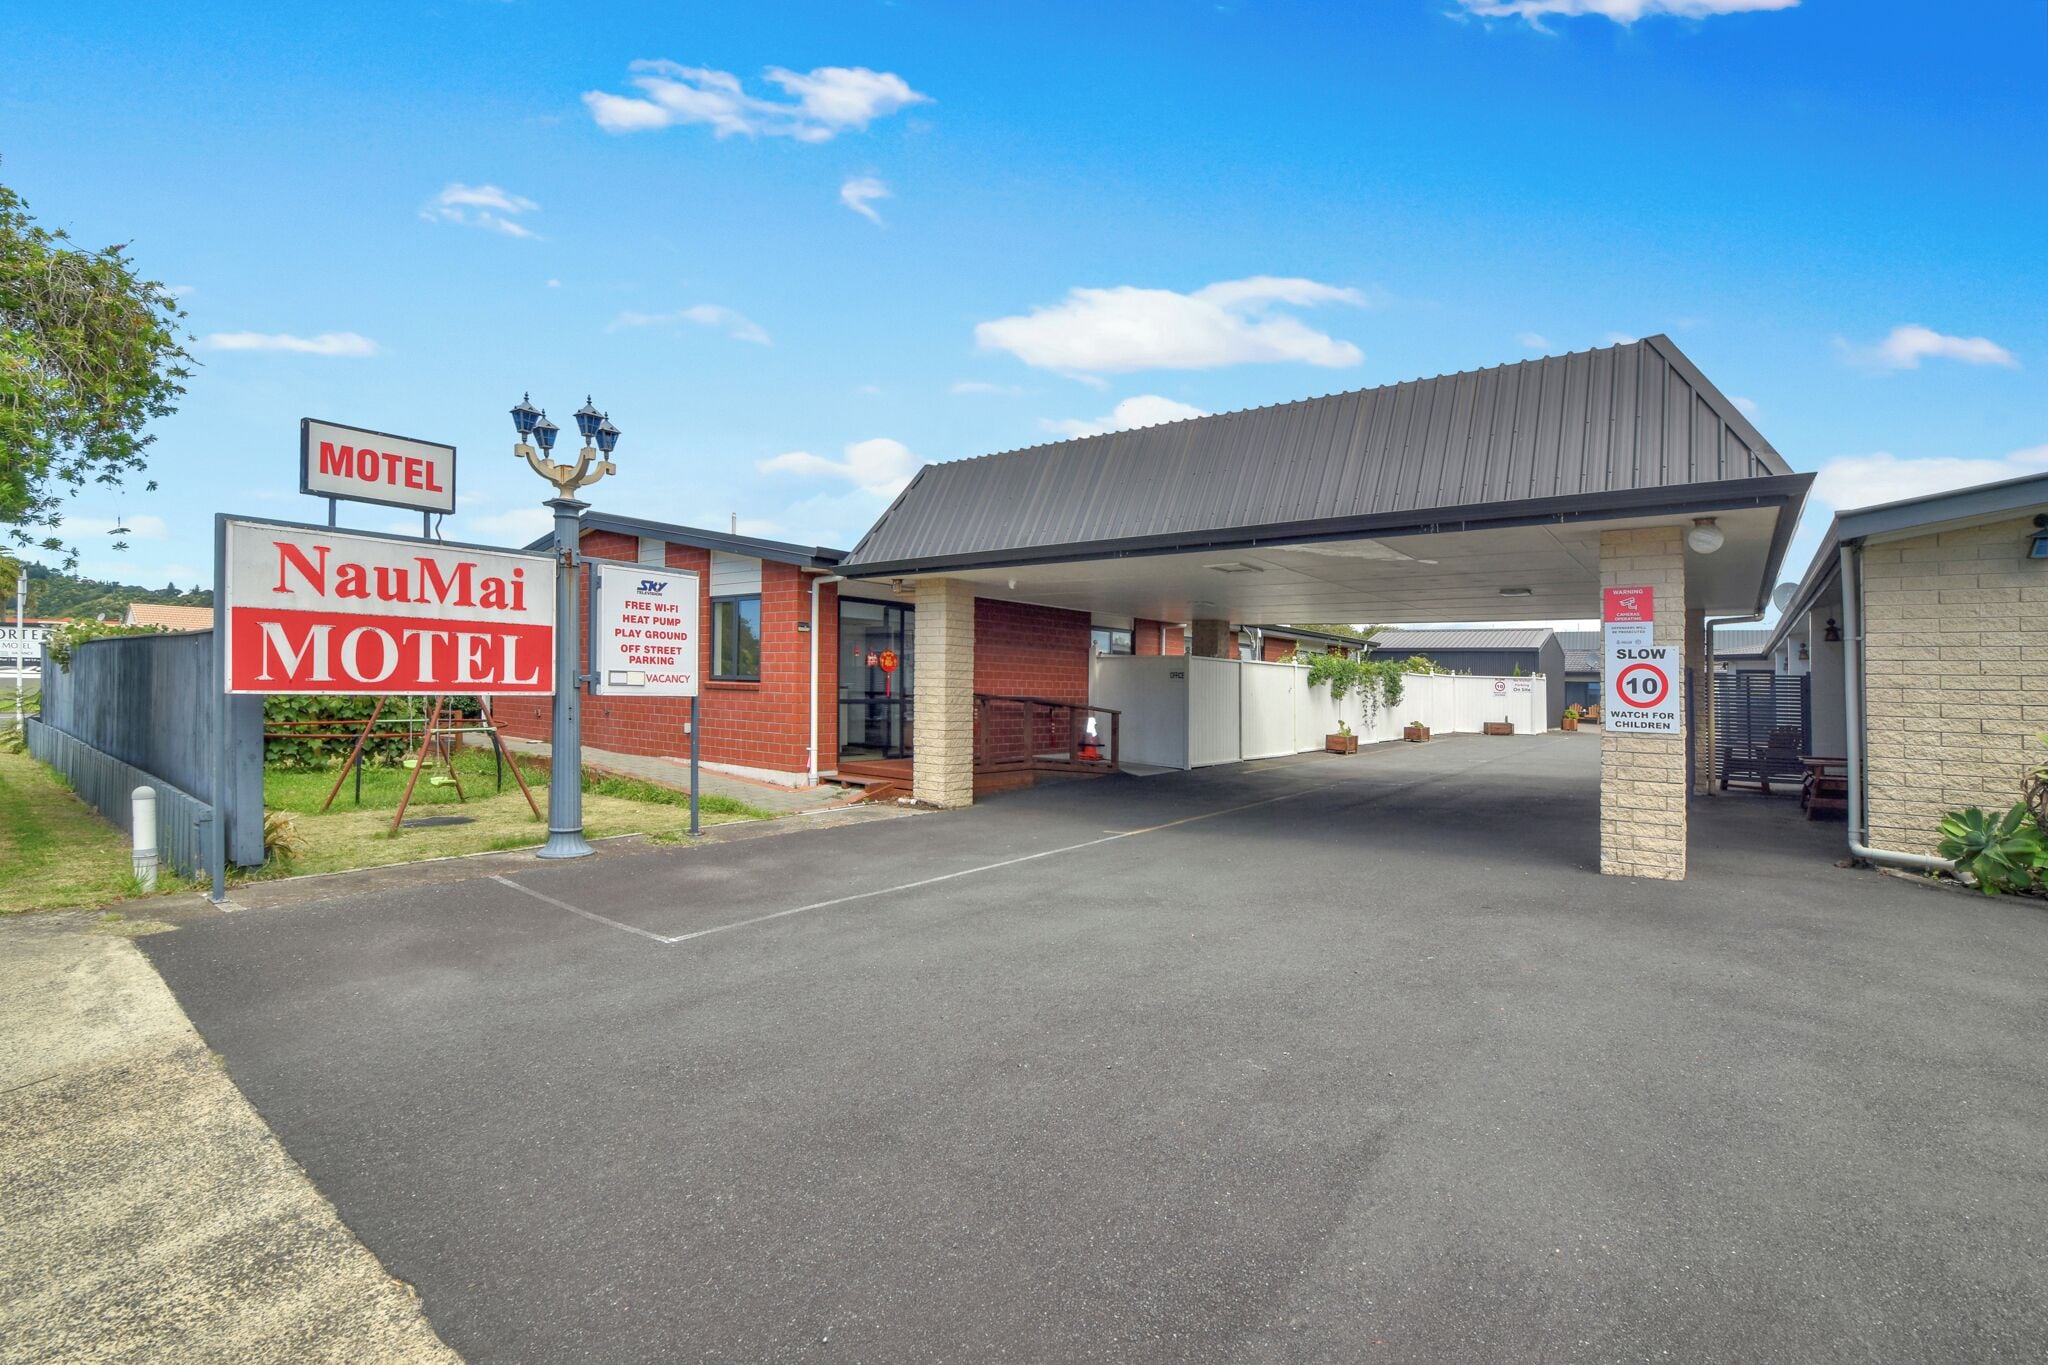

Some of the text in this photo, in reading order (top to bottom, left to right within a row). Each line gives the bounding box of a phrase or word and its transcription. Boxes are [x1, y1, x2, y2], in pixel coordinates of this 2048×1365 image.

[320, 441, 443, 493] MOTEL
[272, 541, 527, 611] NauMai
[637, 580, 668, 592] SKY
[625, 600, 679, 613] FREE WI-FI
[622, 614, 681, 627] HEAT PUMP
[614, 628, 688, 641] PLAY GROUND
[2, 642, 31, 650] MOEL
[620, 644, 682, 655] OFF STREET
[254, 621, 539, 685] MOTEL
[1616, 648, 1666, 660] SLOW
[629, 656, 675, 666] PARKING
[646, 674, 690, 683] VACANCY
[1626, 677, 1658, 695] 10
[1610, 711, 1675, 720] WATCH FOR
[1615, 721, 1671, 730] CHILDREN
